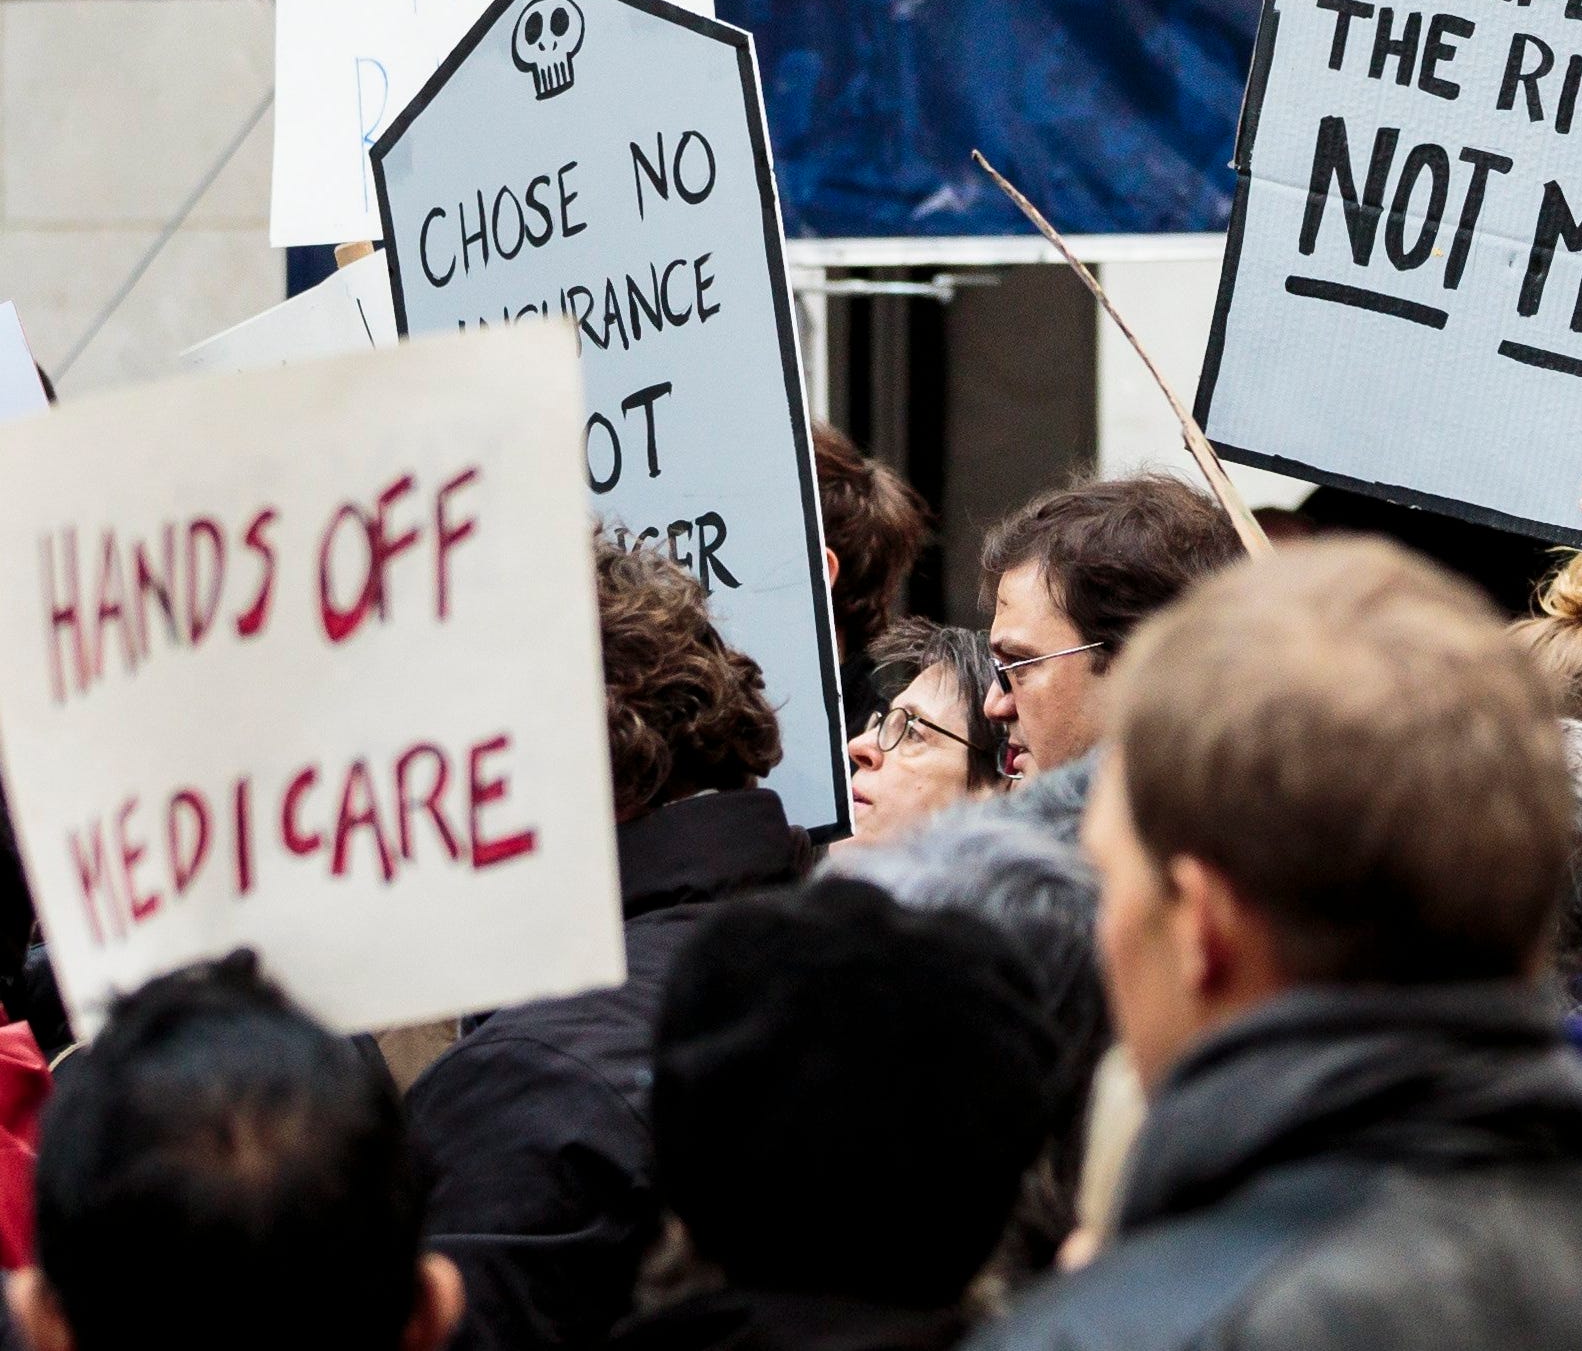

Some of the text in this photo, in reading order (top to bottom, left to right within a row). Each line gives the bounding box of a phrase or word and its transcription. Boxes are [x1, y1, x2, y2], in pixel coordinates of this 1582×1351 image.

[419, 129, 718, 288] CHOSE NO
[1298, 115, 1512, 292] NOT
[457, 251, 722, 359] RANCE
[38, 465, 482, 706] HANDS OFF
[67, 732, 539, 948] MEDICARE
